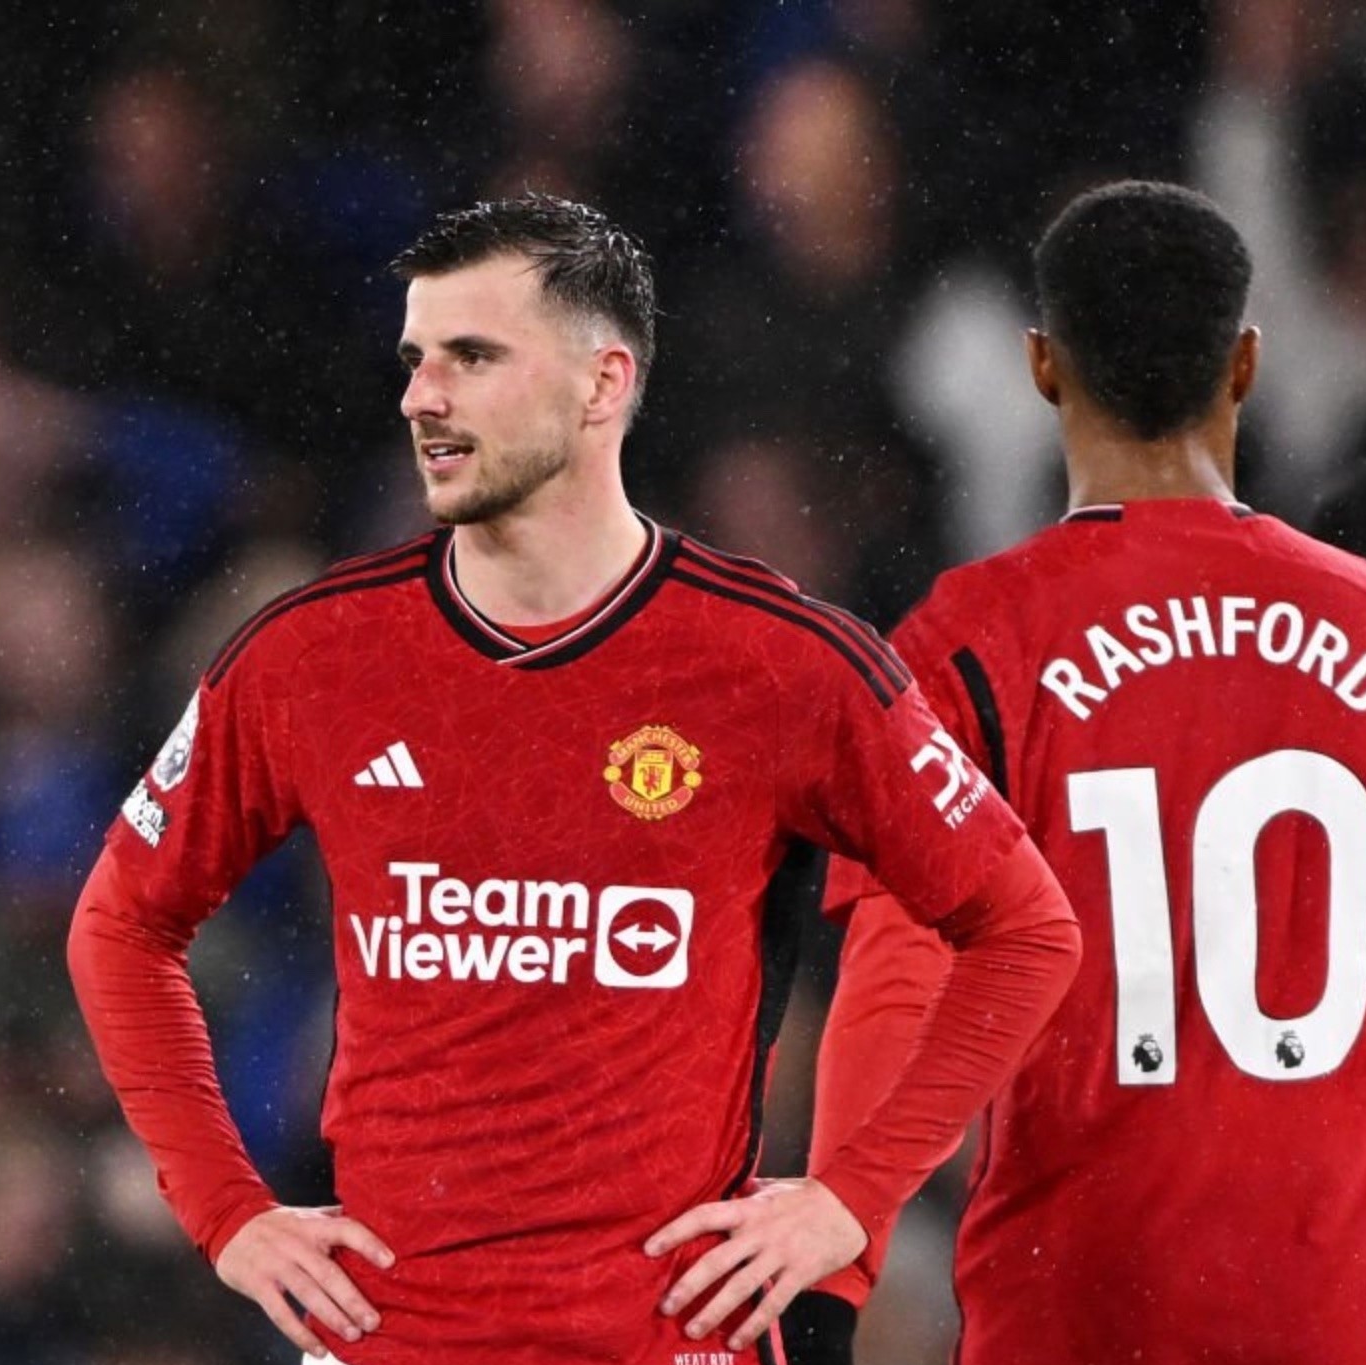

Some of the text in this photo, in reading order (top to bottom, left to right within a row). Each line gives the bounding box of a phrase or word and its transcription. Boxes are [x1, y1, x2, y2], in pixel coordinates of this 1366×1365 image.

[623, 794, 679, 816] UNITED
[388, 861, 590, 930] Team
[349, 913, 587, 985] Viewer
